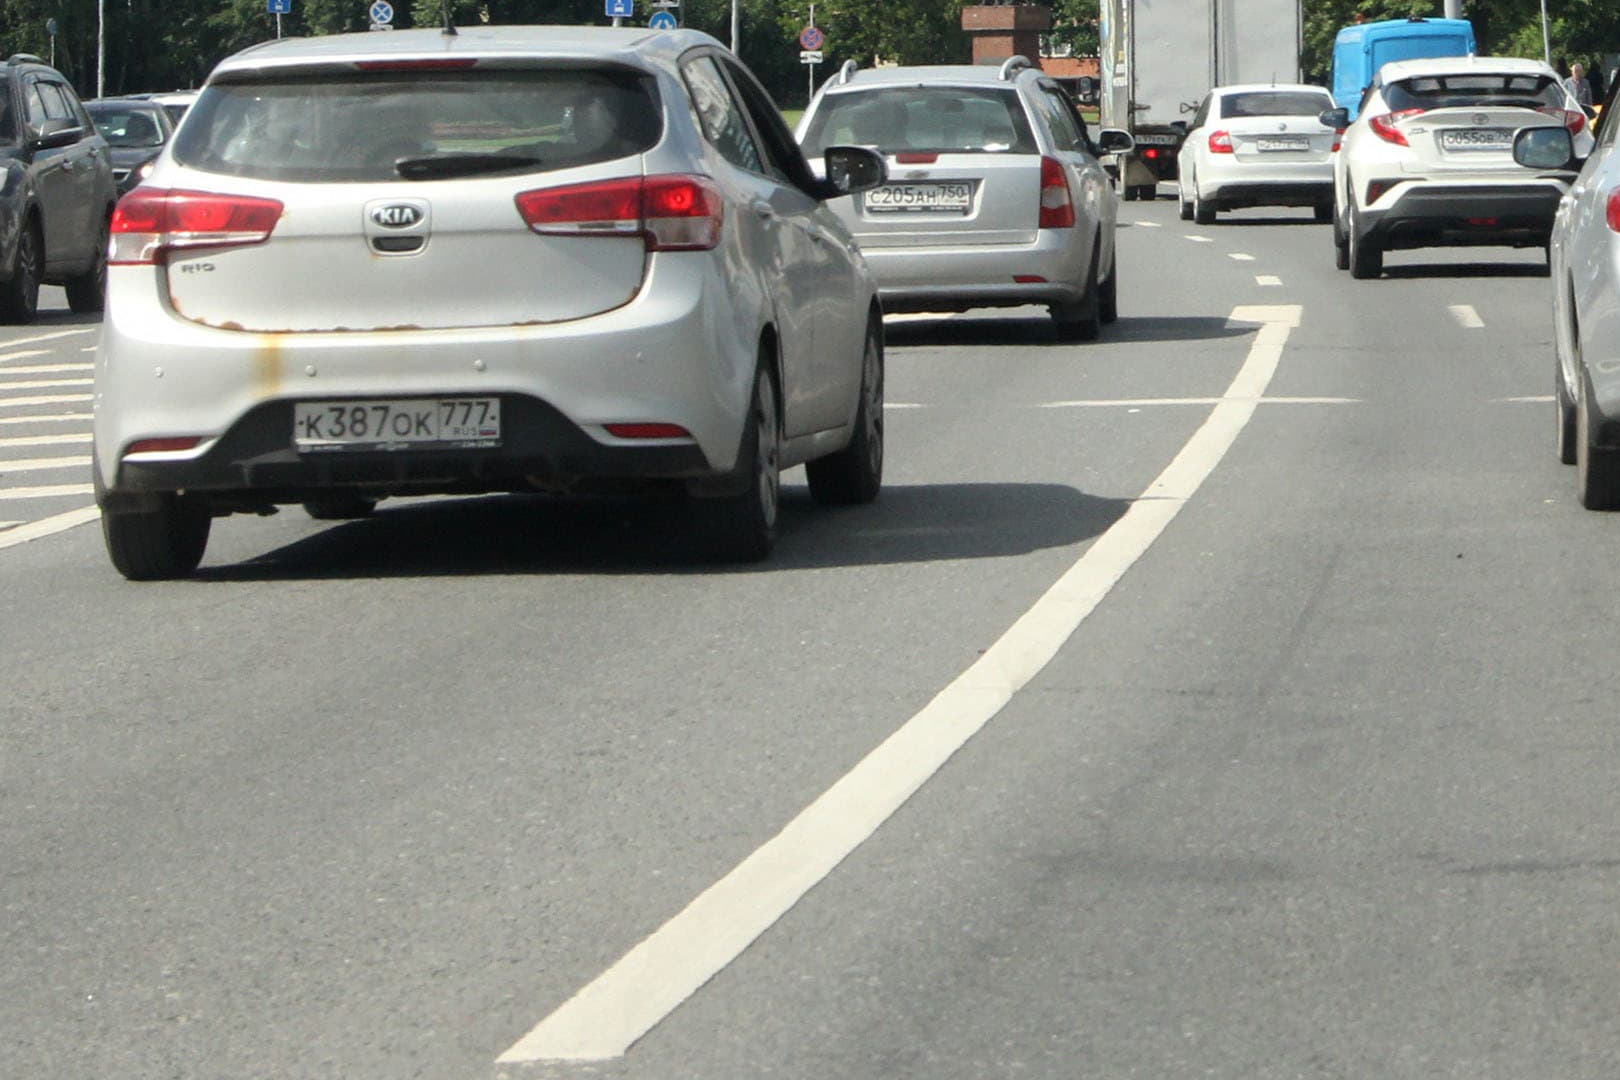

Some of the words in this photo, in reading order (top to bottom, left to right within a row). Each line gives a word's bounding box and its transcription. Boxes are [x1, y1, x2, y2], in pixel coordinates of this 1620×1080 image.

[379, 206, 415, 225] KIA
[440, 401, 490, 426] 777
[453, 427, 478, 436] RUS
